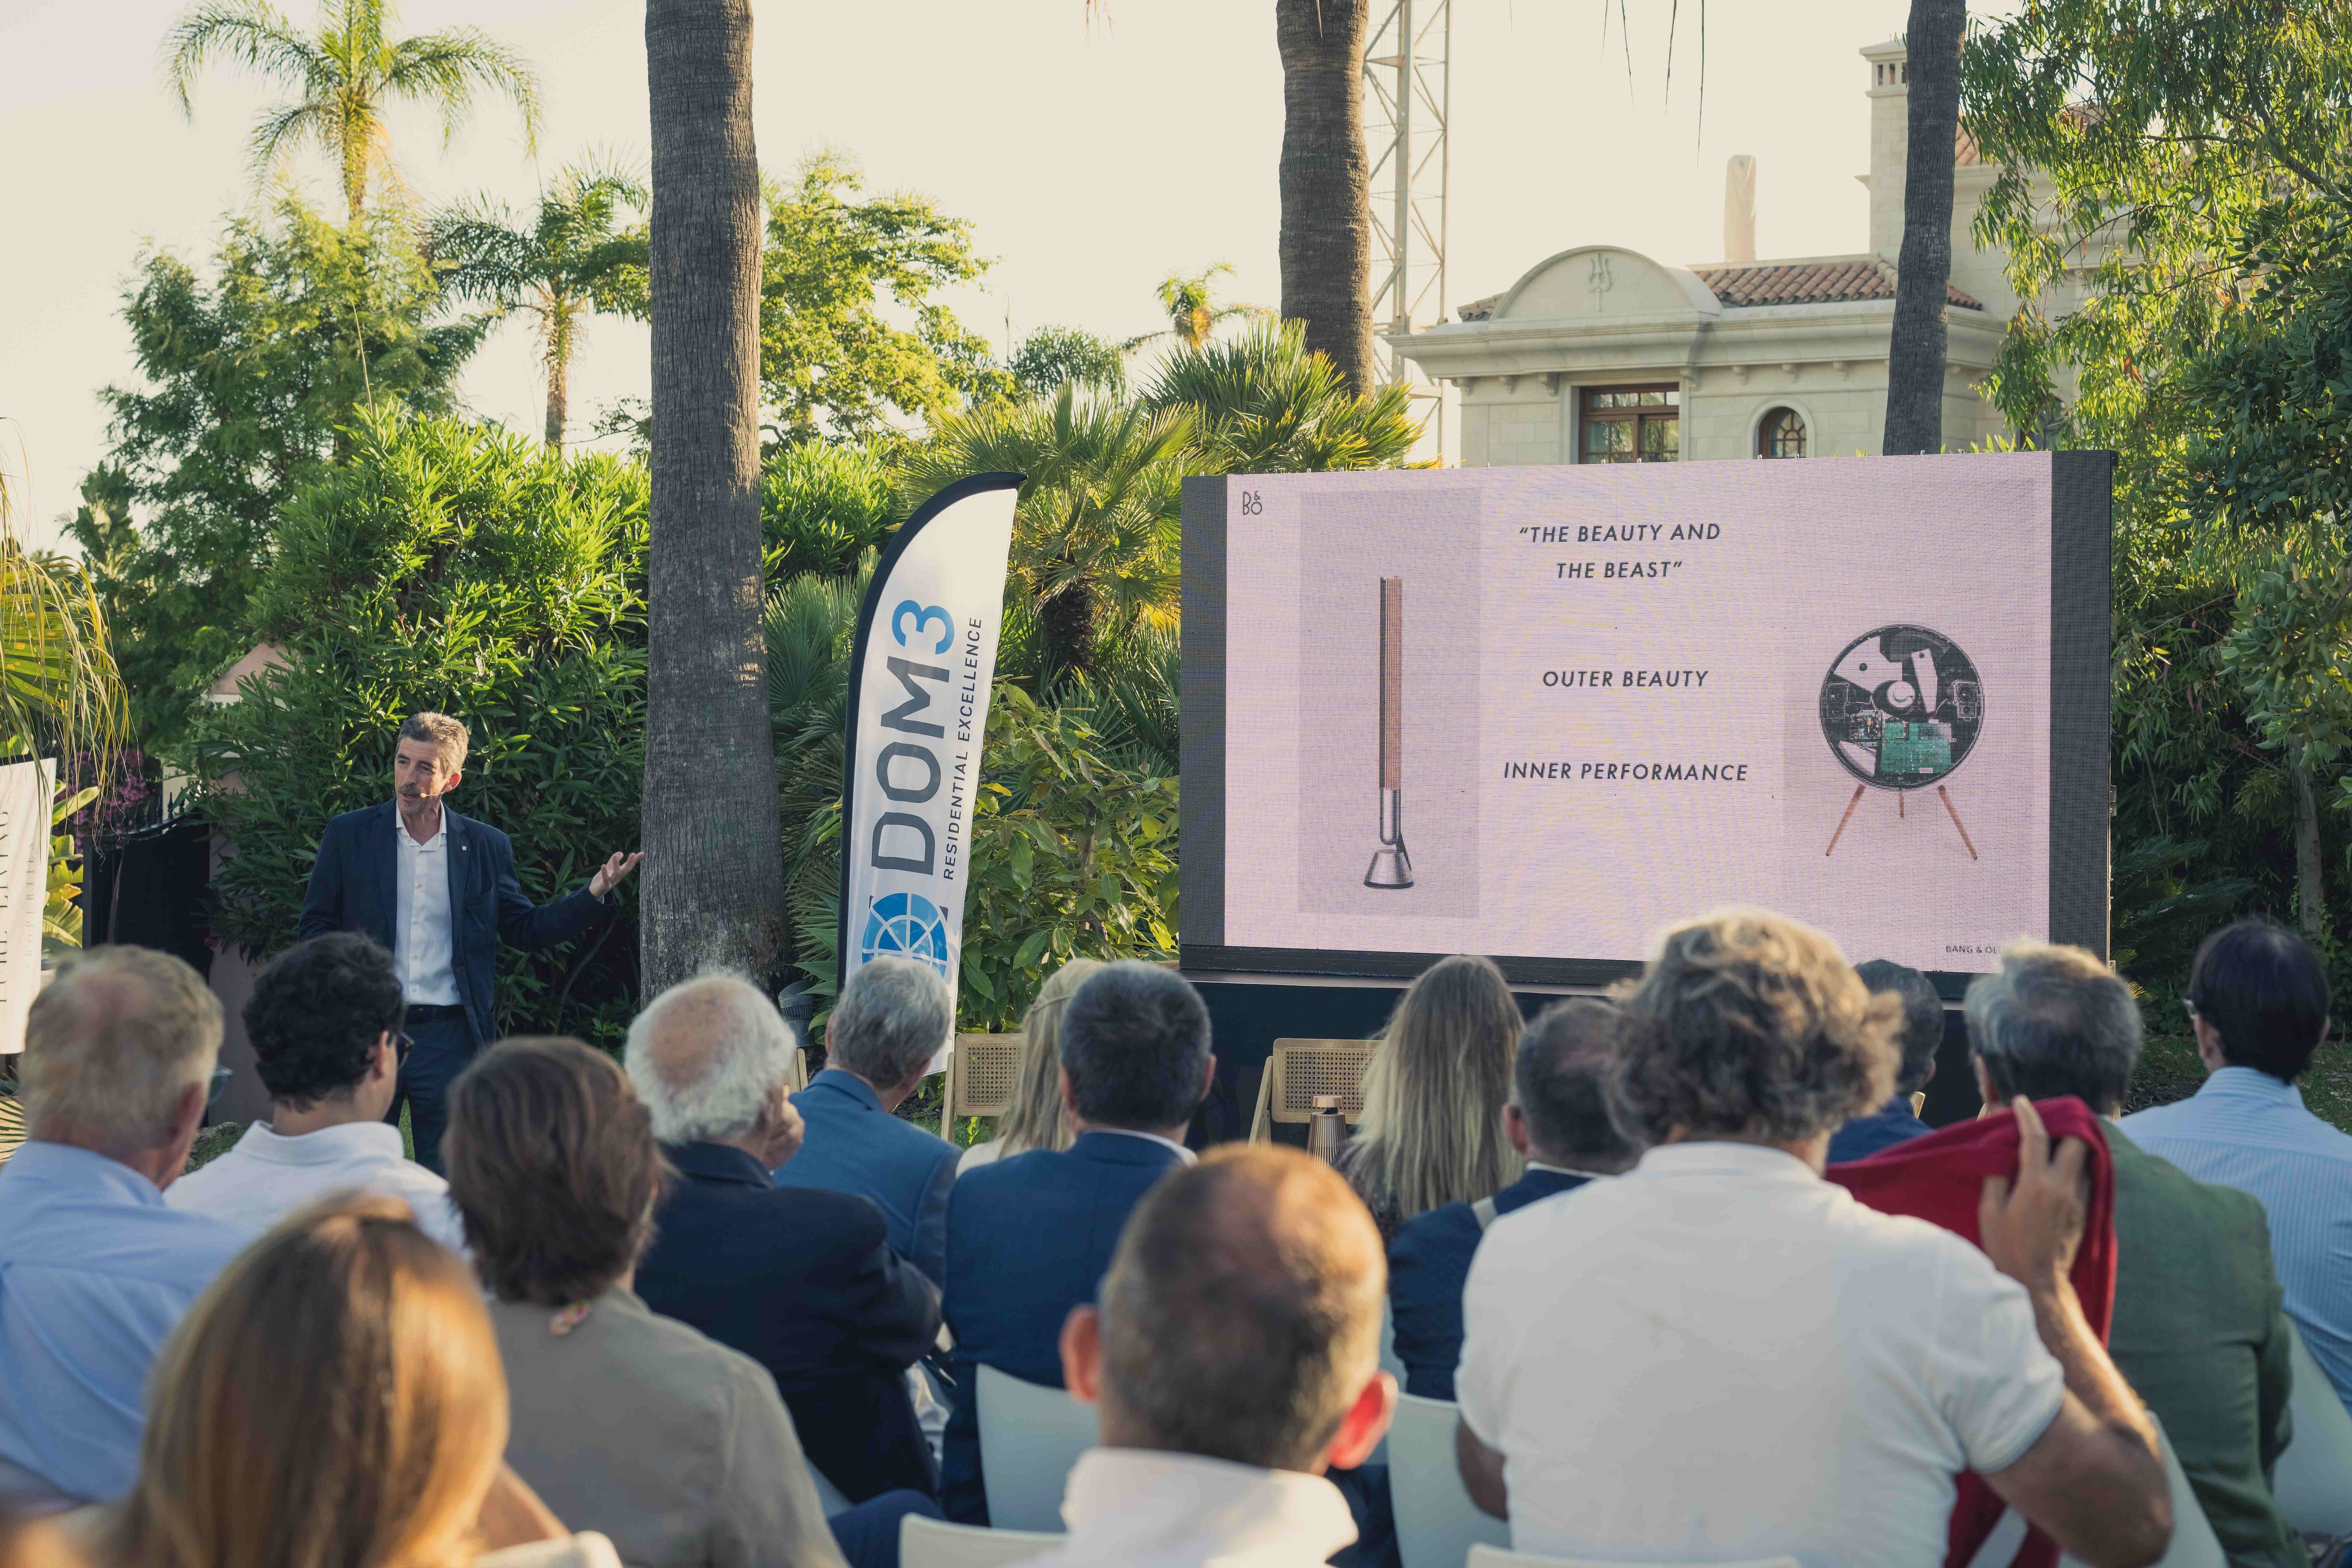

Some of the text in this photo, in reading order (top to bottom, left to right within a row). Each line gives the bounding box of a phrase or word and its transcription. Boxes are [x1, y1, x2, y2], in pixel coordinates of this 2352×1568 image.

[1578, 524, 1662, 542] BEAUTY
[1670, 523, 1721, 541] AND
[1557, 563, 1595, 579] THE
[1542, 670, 1709, 687] OUTER BEAUTY
[871, 600, 954, 875] DOM3
[943, 618, 981, 880] RESIDENTIAL EXCELLENCE
[1504, 762, 1748, 781] INNER PERFORMANCE
